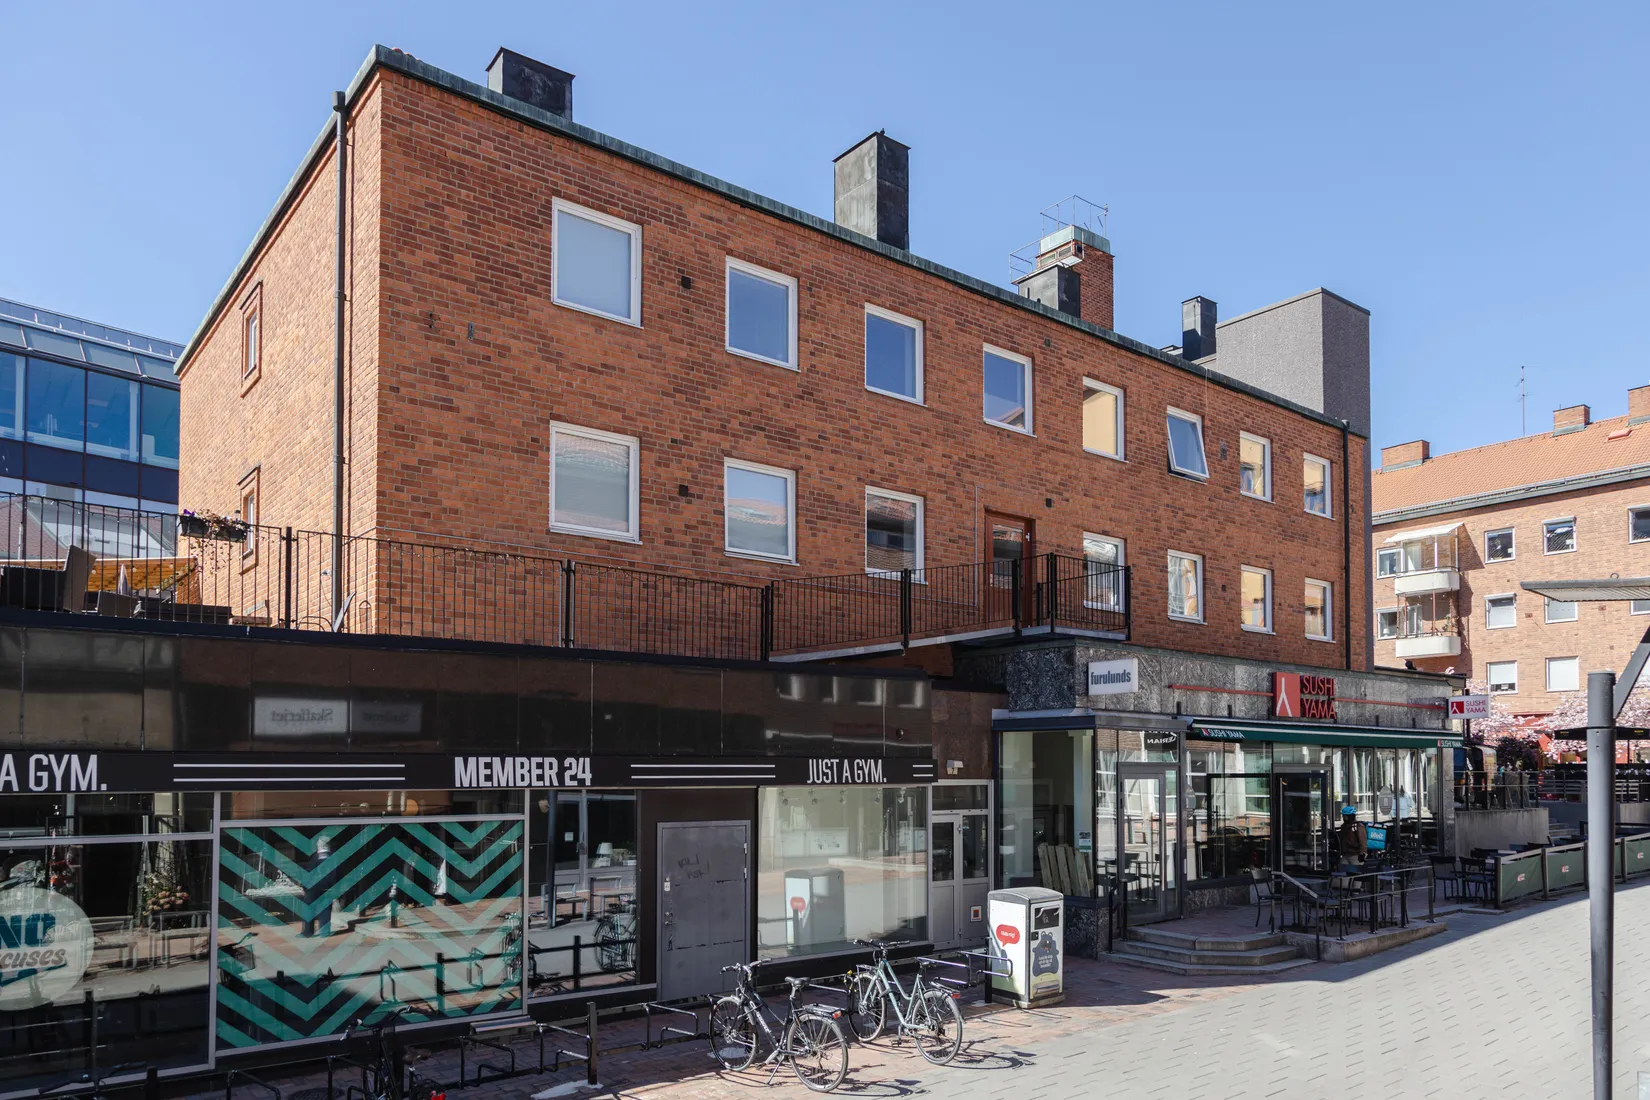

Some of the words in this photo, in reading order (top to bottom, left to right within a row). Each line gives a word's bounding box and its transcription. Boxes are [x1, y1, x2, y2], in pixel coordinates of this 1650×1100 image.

[1090, 669, 1132, 685] furulunds
[1303, 675, 1336, 697] SUSHI
[1303, 697, 1337, 719] YAMA
[0, 753, 19, 792] A
[29, 753, 107, 792] GYM.
[454, 756, 559, 788] MEMBER
[564, 757, 592, 786] 24
[807, 758, 840, 783] JUST
[842, 758, 852, 783] A
[853, 758, 887, 783] GYM.
[0, 948, 66, 969] cuses
